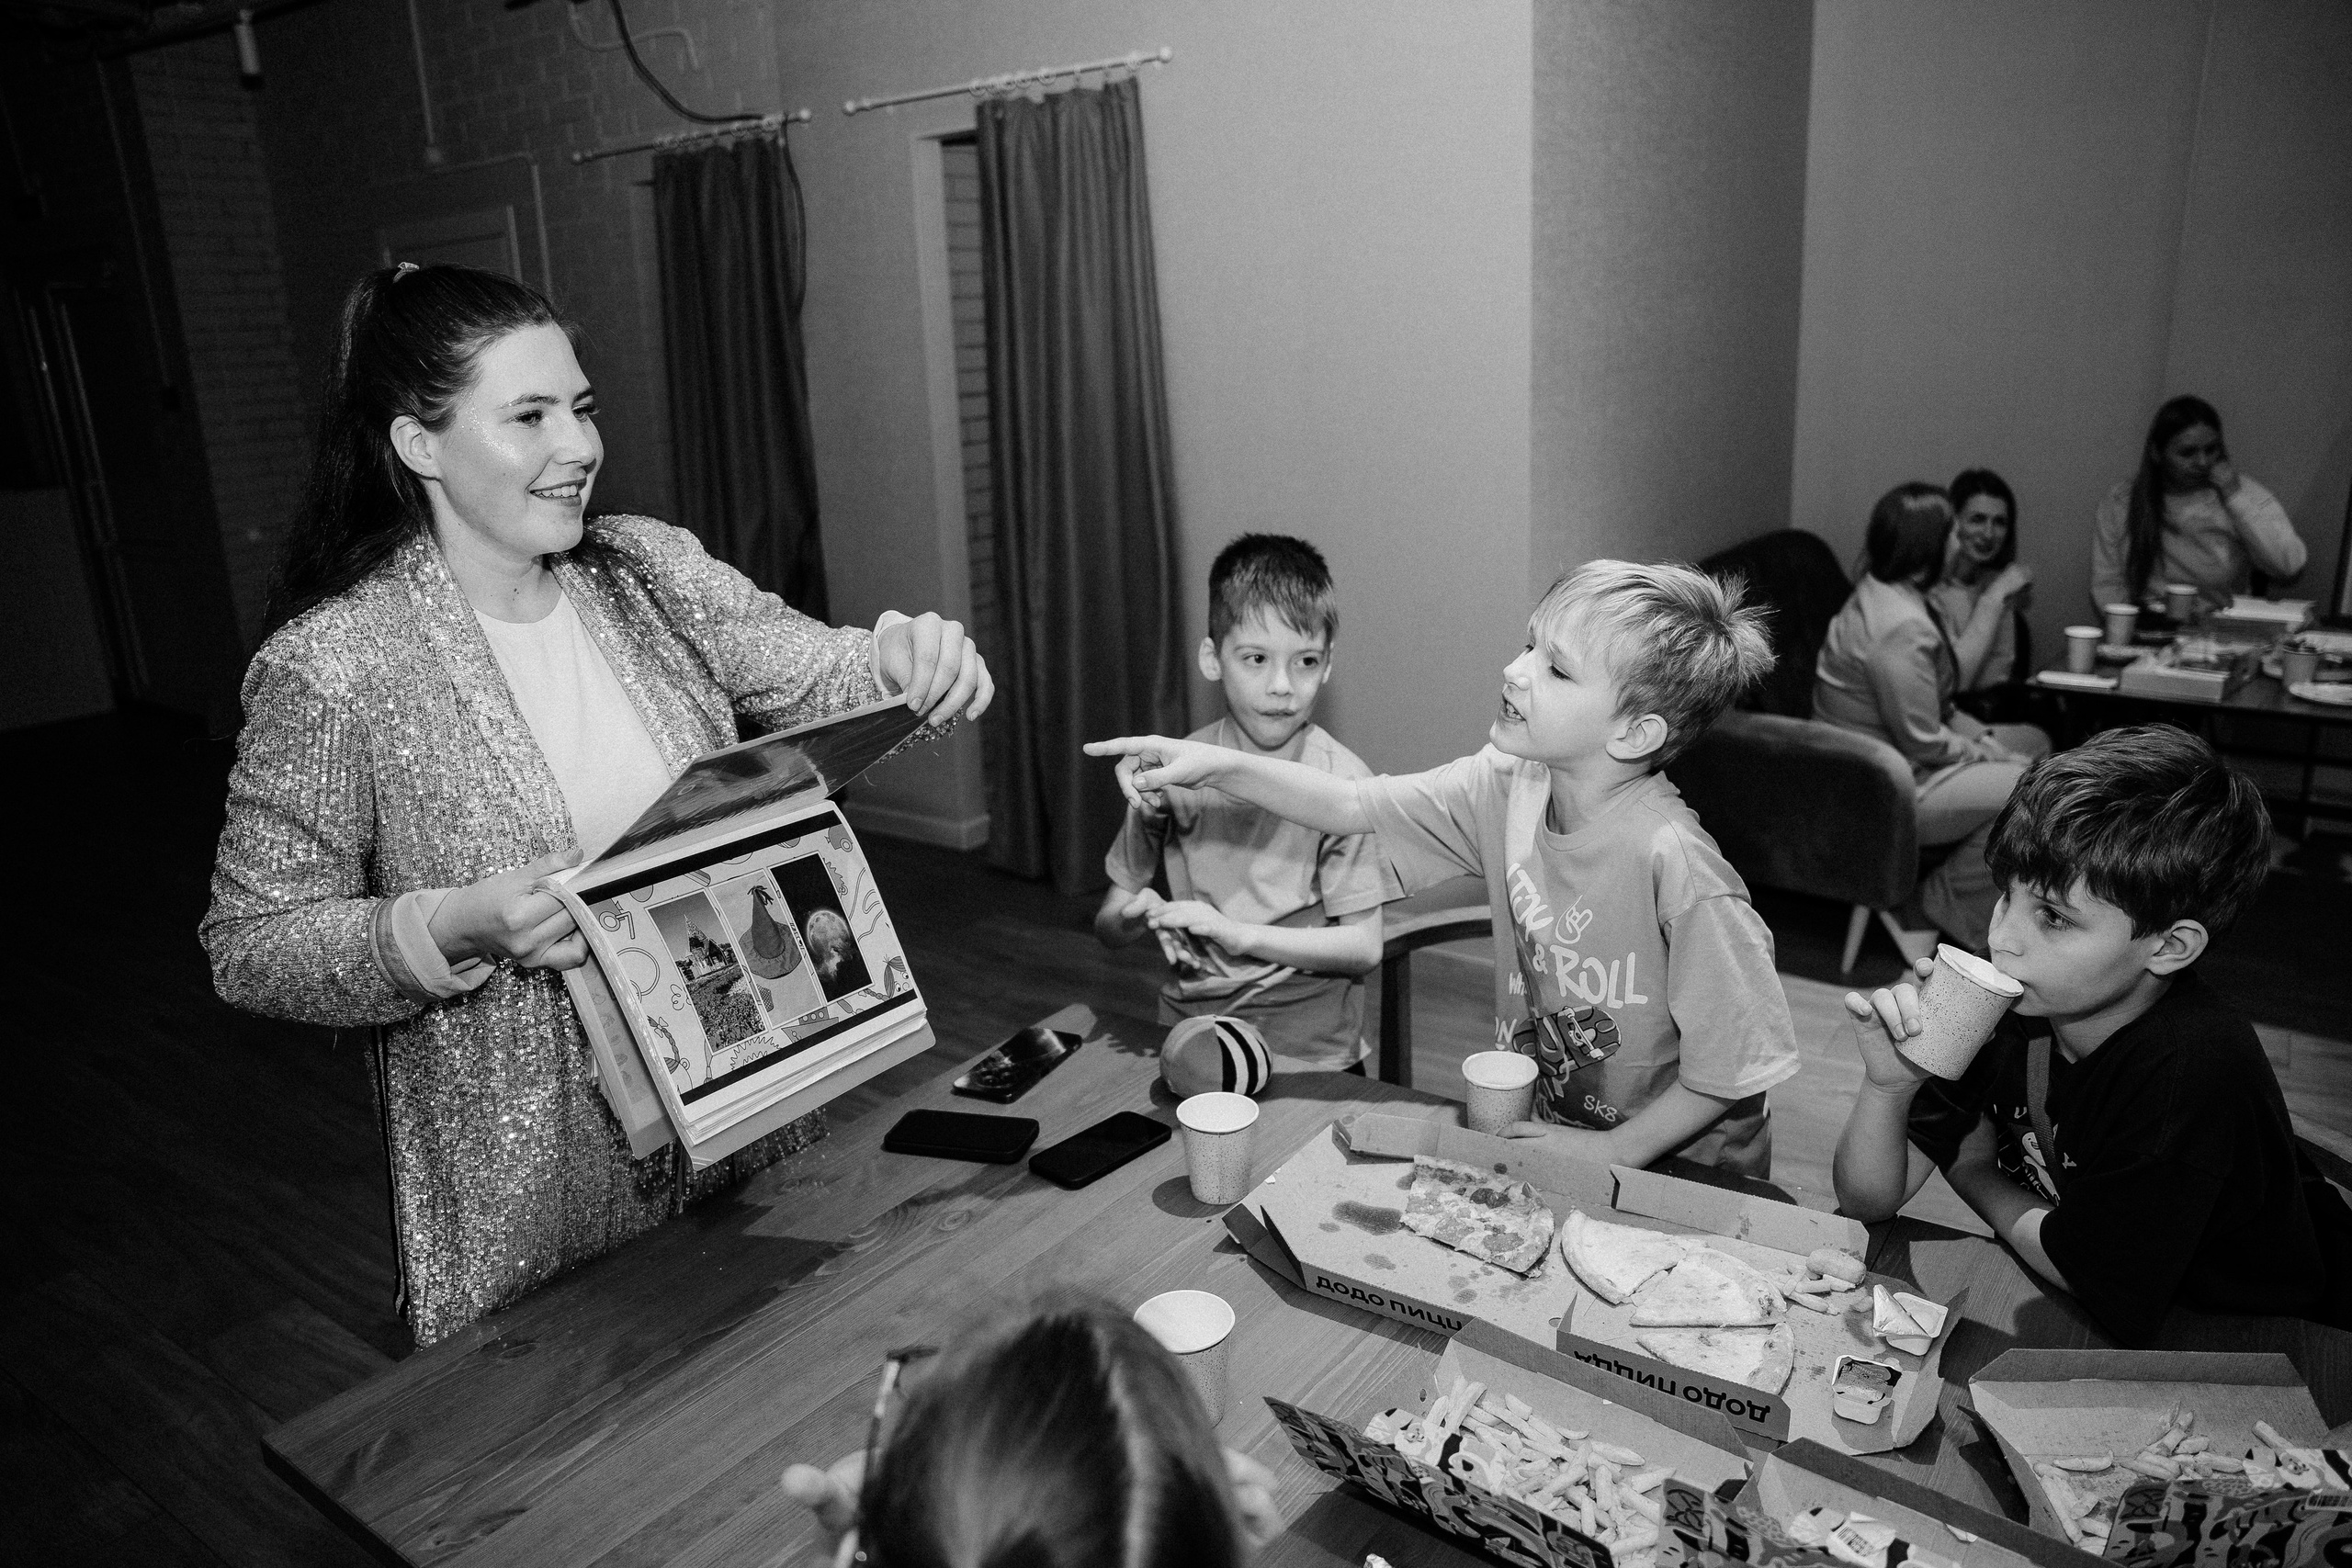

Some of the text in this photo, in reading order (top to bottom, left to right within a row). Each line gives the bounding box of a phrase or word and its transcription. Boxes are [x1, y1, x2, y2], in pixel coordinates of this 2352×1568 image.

[1550, 944, 1648, 1009] ROLL
[1583, 1094, 1619, 1122] SK8
[1316, 1275, 1463, 1332] ДОДО ПИЦЦ
[1683, 1385, 1771, 1424] ДОДО
